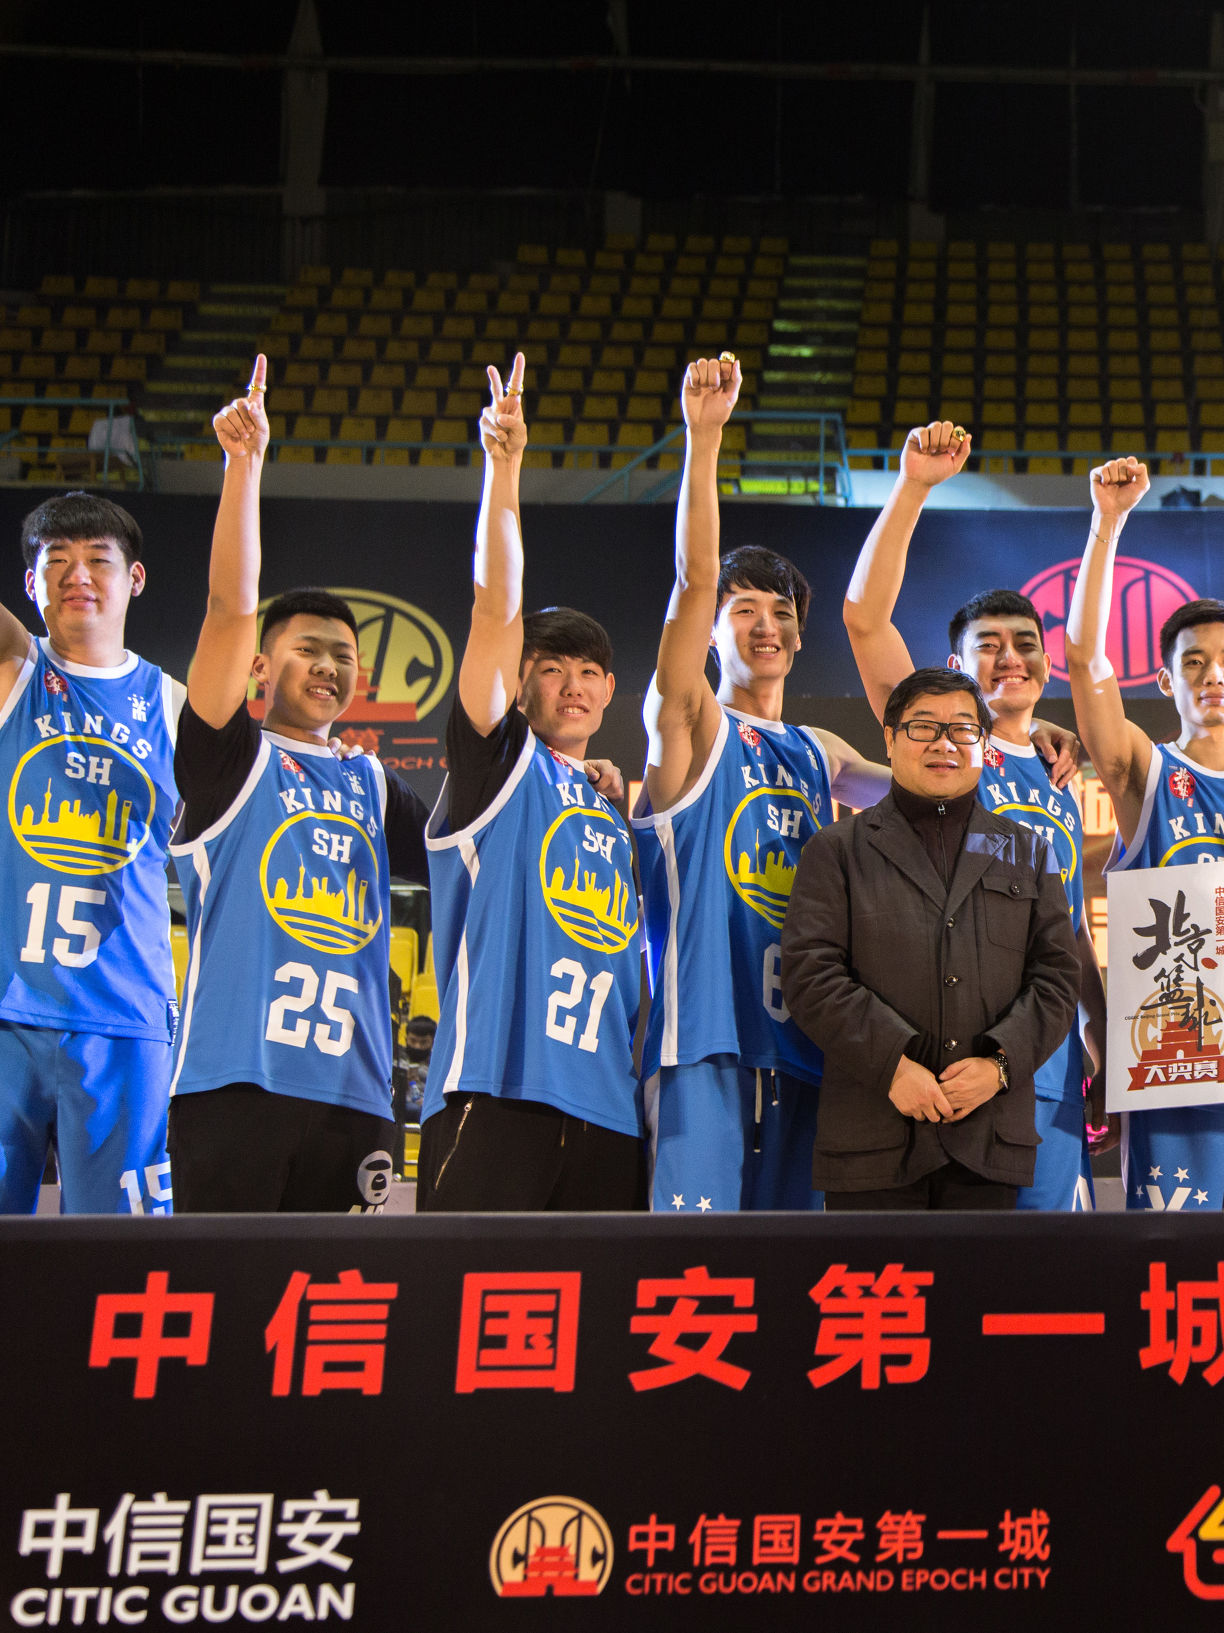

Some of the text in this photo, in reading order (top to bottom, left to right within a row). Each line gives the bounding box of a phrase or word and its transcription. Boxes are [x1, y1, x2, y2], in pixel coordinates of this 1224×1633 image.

[34, 711, 152, 760] KINGS
[64, 751, 113, 786] SH
[741, 763, 821, 815] KINGS
[279, 787, 379, 839] KINGS
[767, 803, 804, 839] SH
[986, 781, 1076, 832] KINGS
[312, 827, 353, 864] SH
[582, 824, 616, 865] SH
[20, 882, 107, 969] 15
[264, 961, 360, 1057] 25
[546, 957, 614, 1054] 21
[1144, 1060, 1219, 1085] 大奖赛
[18, 1490, 362, 1578] 中信国安
[627, 1508, 1052, 1568] 中信国安第一城
[10, 1583, 356, 1627] CITIC GUOAN
[625, 1567, 1051, 1595] CITIC GUOAN GRAND EPOCH CITY
